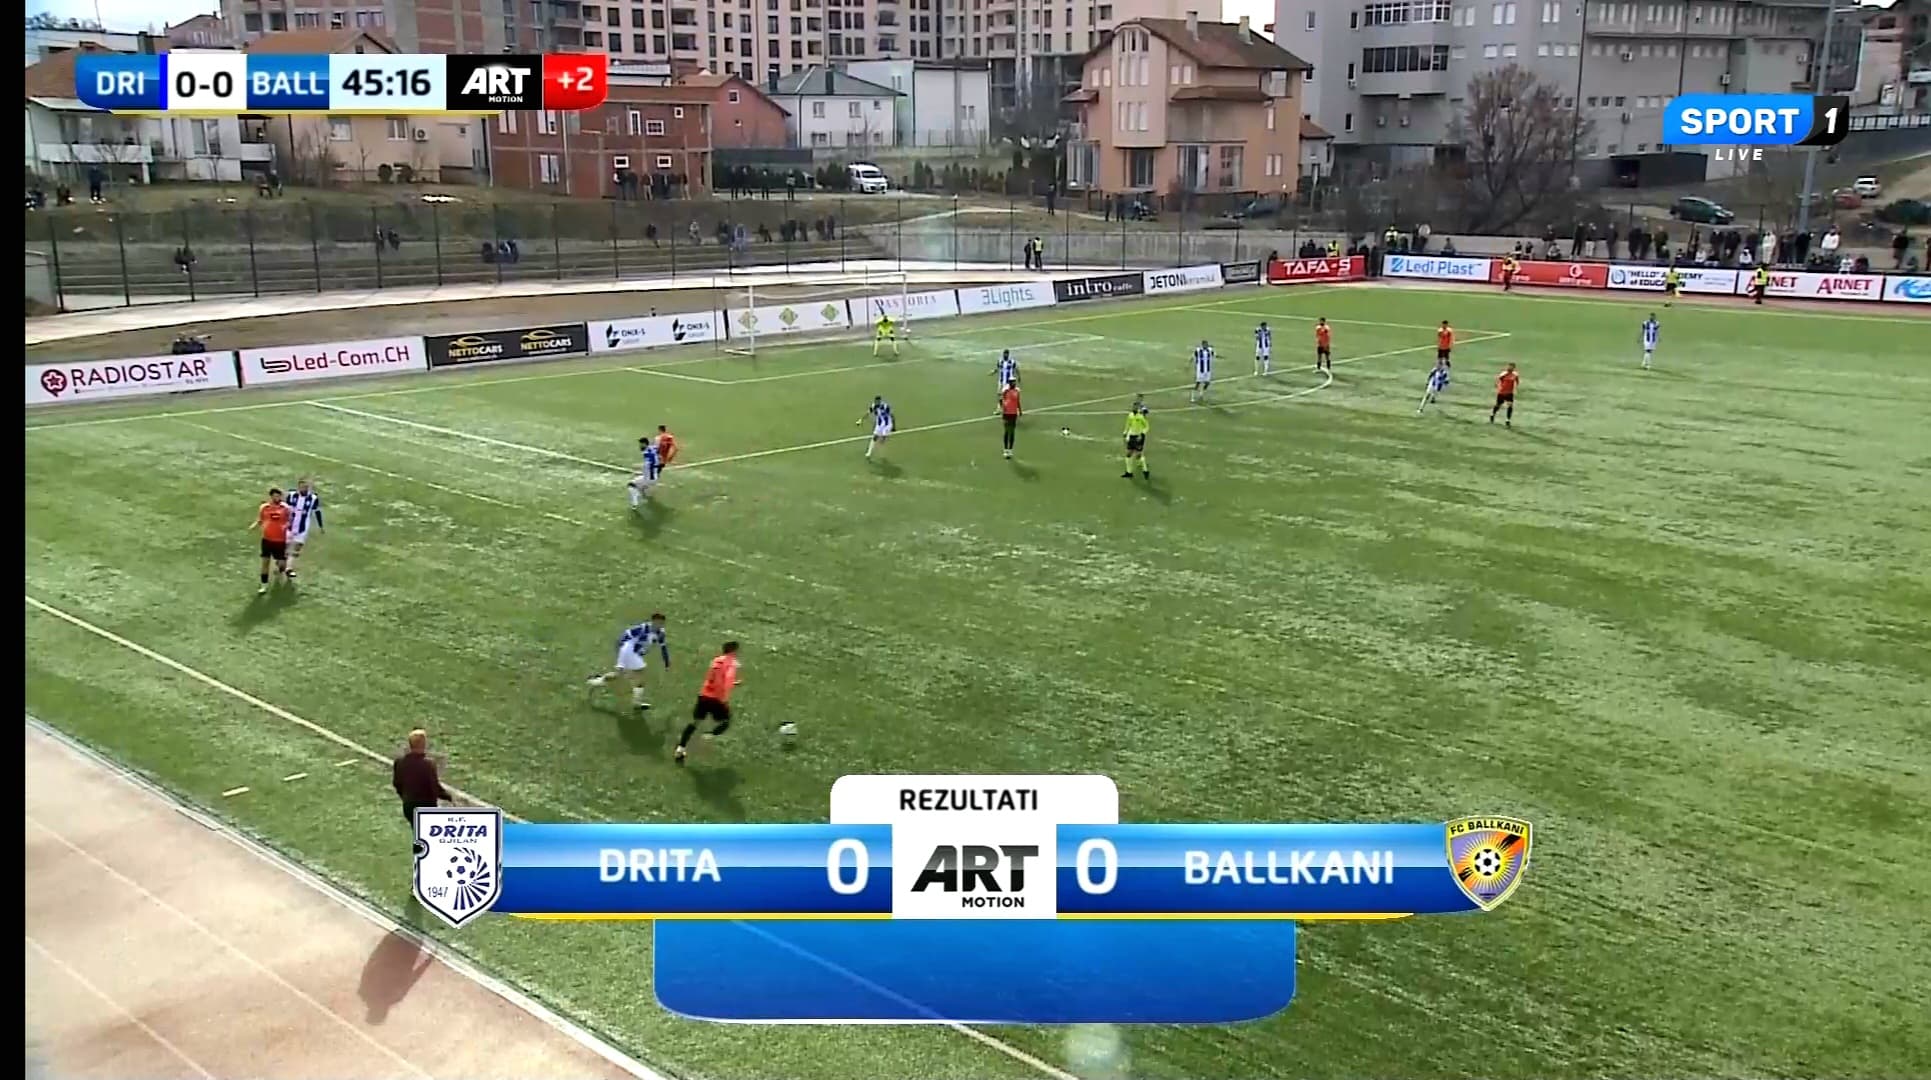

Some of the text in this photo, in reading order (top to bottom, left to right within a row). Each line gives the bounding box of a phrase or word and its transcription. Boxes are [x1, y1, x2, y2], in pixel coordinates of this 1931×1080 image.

[1438, 260, 1473, 275] Plast
[1067, 278, 1112, 296] intro
[1816, 278, 1874, 294] ARNET
[981, 287, 1035, 307] 3Lights
[292, 345, 410, 371] Led-Com.CH
[70, 359, 208, 387] RADIOSTAR
